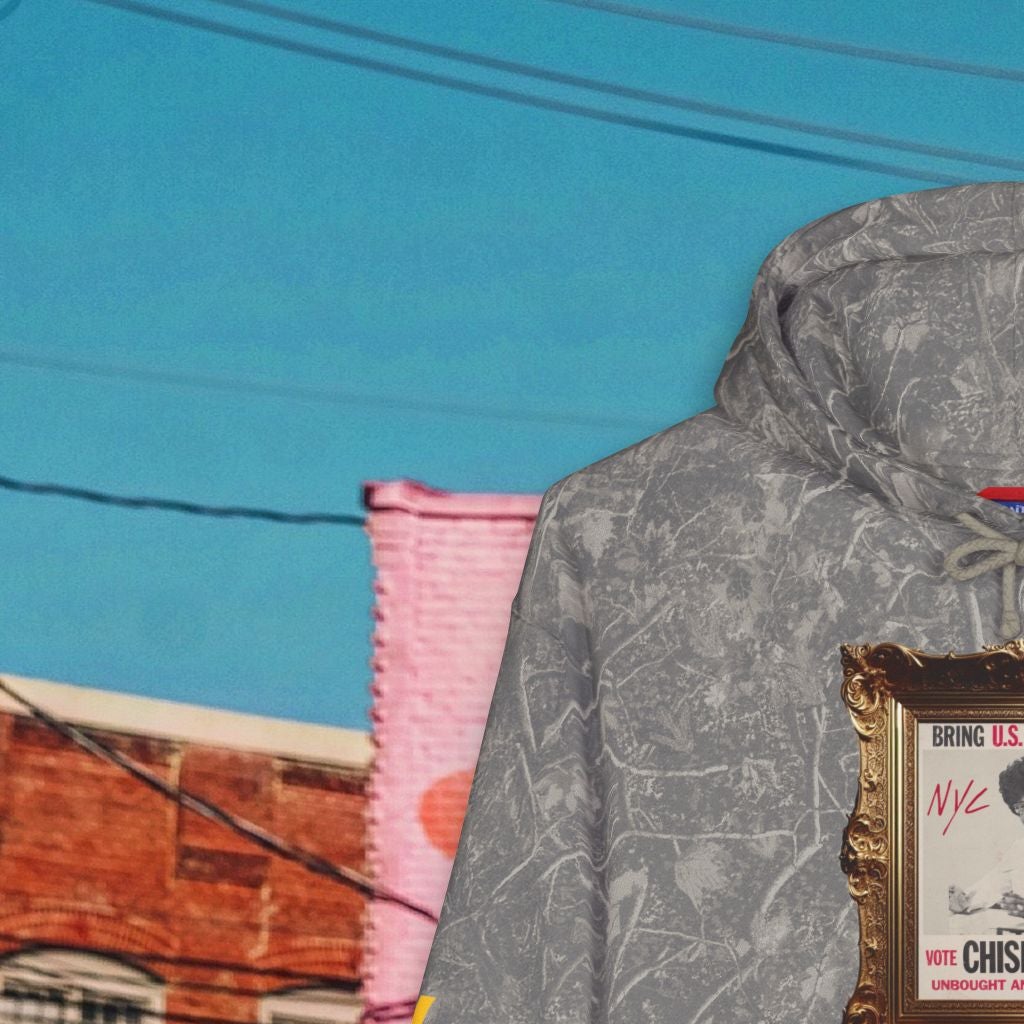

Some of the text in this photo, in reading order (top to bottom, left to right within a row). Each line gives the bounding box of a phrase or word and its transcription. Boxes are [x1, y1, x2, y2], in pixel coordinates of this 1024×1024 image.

[932, 724, 985, 747] BRING
[992, 724, 1023, 747] U.S.
[927, 779, 990, 836] NYC
[925, 949, 957, 966] VOTE
[931, 979, 1006, 991] UNBOUGHT
